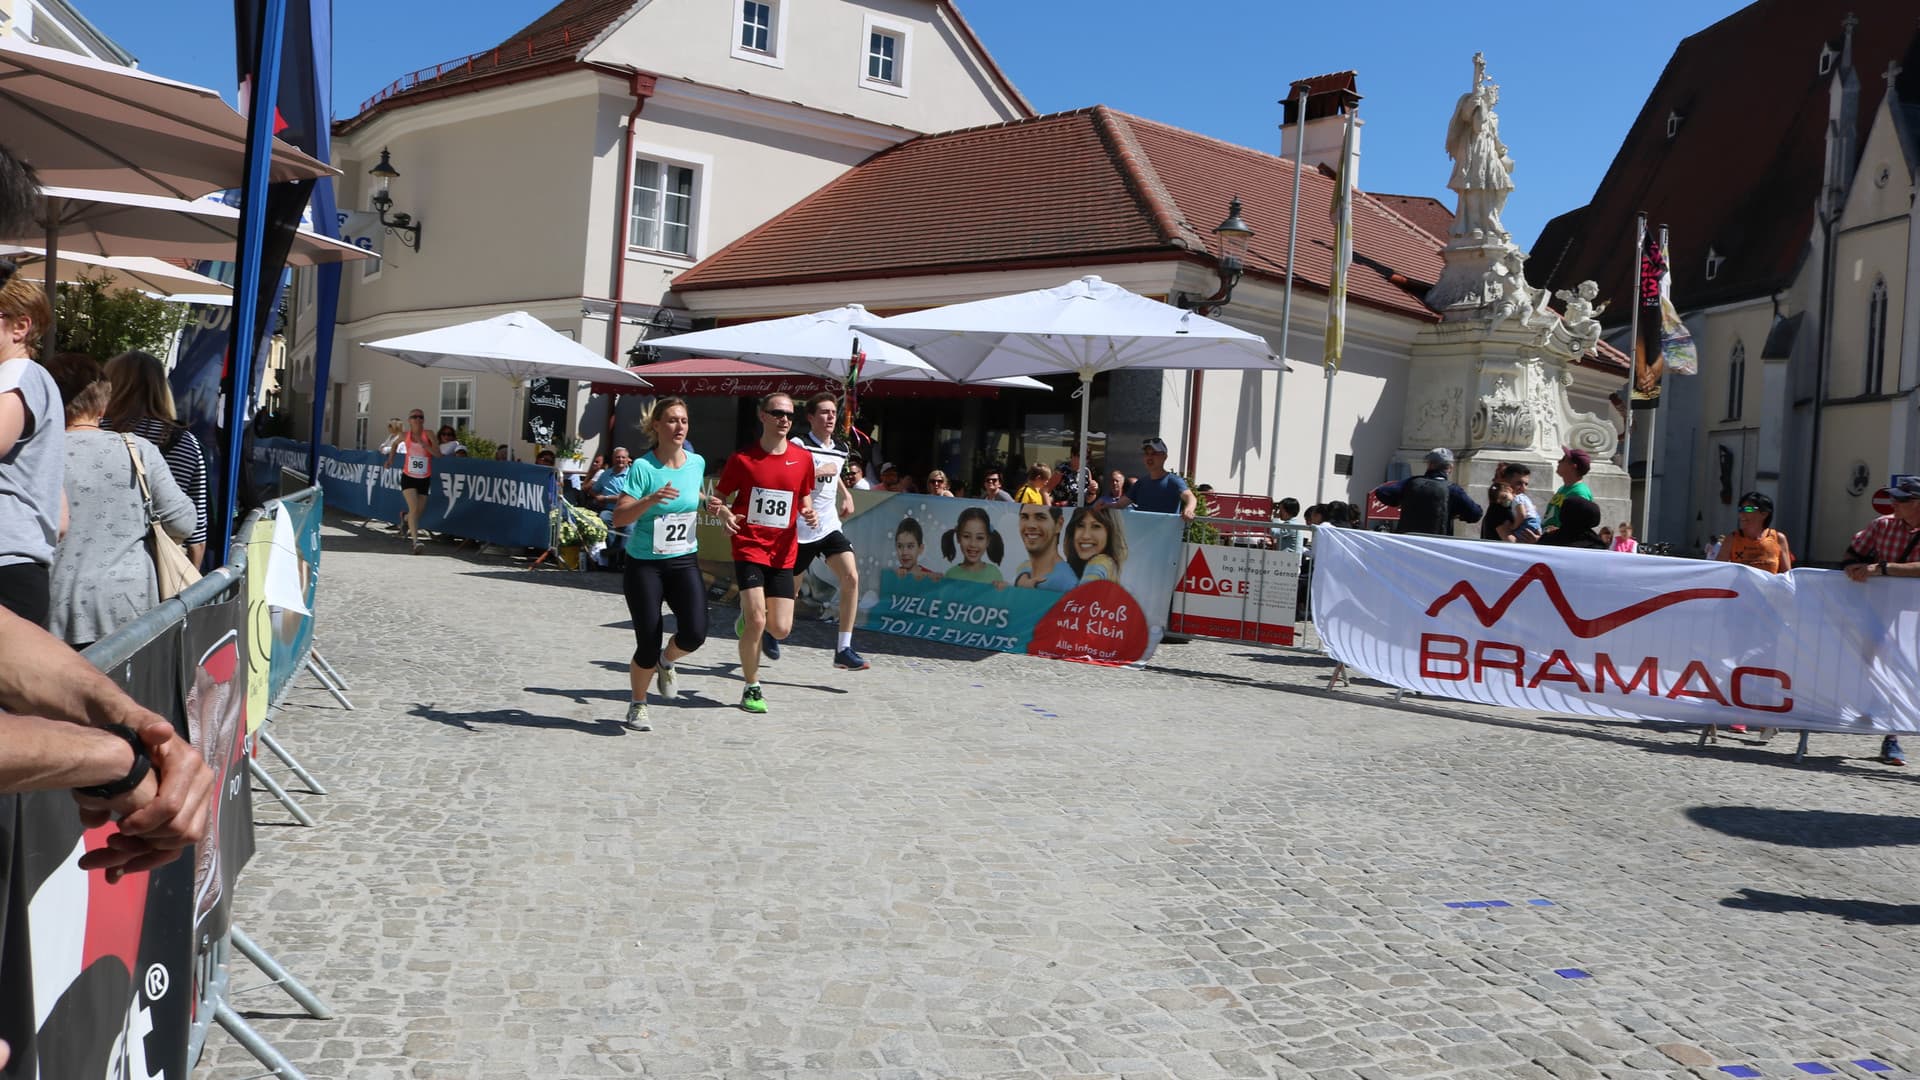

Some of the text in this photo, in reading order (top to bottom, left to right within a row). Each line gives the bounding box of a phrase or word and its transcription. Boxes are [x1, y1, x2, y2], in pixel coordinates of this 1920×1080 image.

[412, 460, 424, 469] 96
[467, 474, 546, 514] VOLKSBANK
[755, 498, 788, 517] 138
[665, 524, 687, 542] 22
[1184, 576, 1250, 594] HOGE
[890, 594, 1009, 629] VIELE SHOPS
[1089, 601, 1128, 622] Groß
[879, 616, 1019, 649] TOLLE EVENTS
[1057, 617, 1124, 639] und Klein
[1056, 640, 1117, 658] Alle Infos auf
[1419, 632, 1794, 714] BRAMAC
